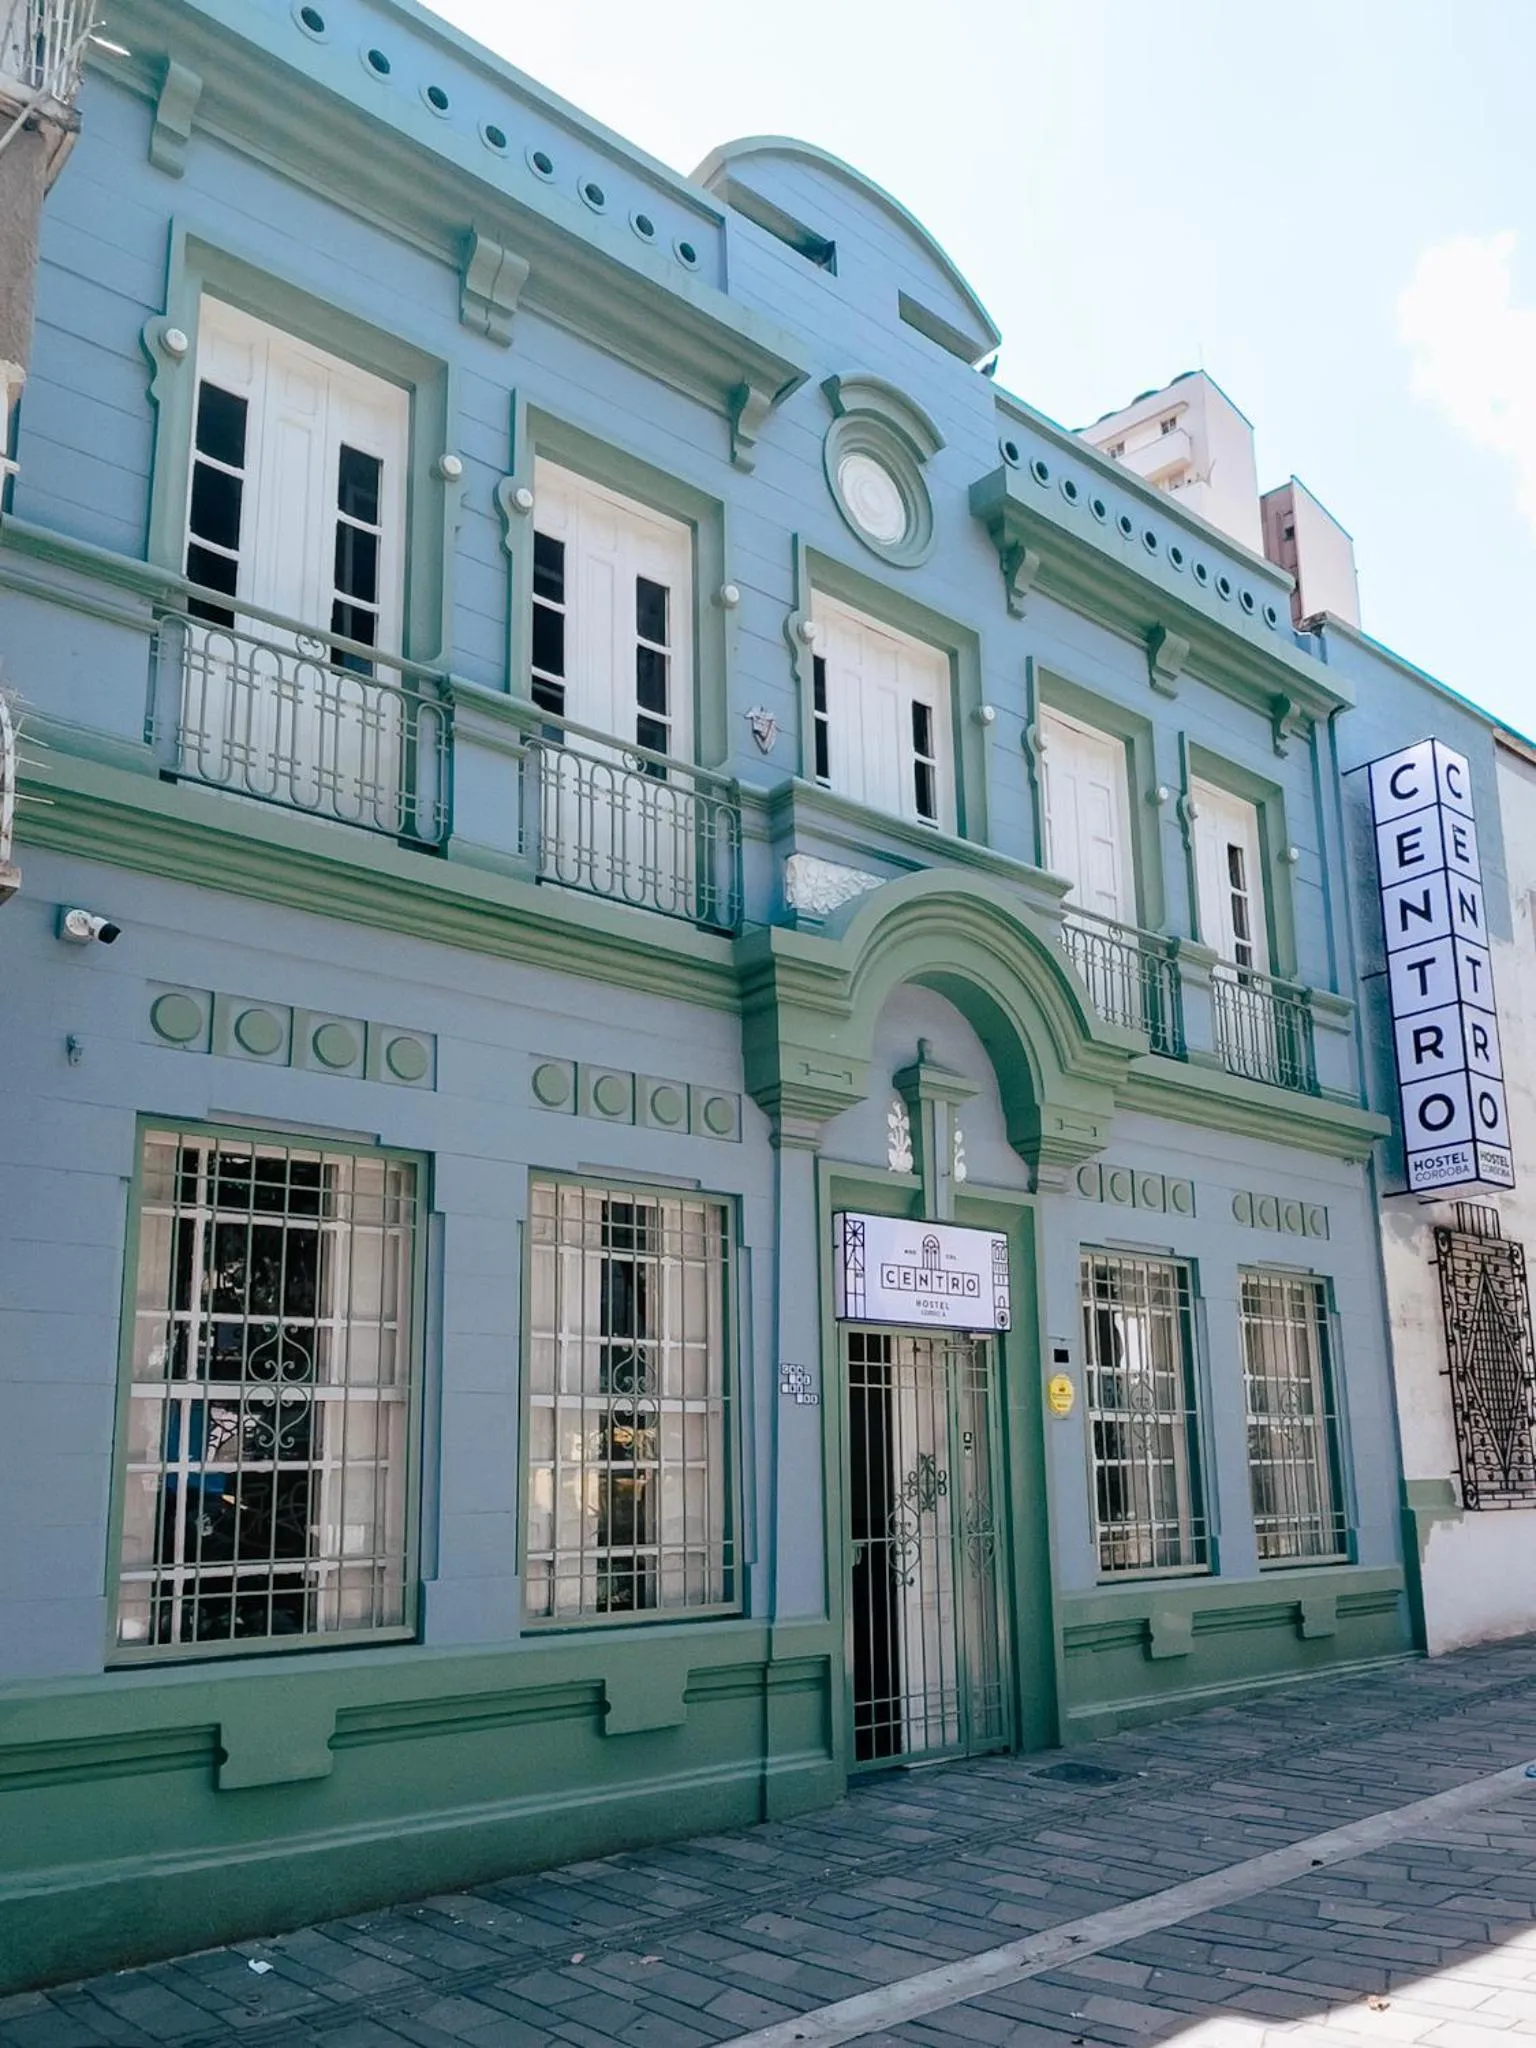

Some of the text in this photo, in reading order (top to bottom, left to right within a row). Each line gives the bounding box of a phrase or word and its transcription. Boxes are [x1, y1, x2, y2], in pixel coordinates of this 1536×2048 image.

[1390, 763, 1455, 1131] CENTRO
[1446, 763, 1499, 1130] CENTRO
[1413, 1152, 1469, 1172] HOSTEL
[1480, 1151, 1510, 1168] HOSTEL
[1415, 1165, 1470, 1181] CORDOBA
[886, 1270, 976, 1292] CENTRO
[915, 1300, 950, 1311] HOSTEL
